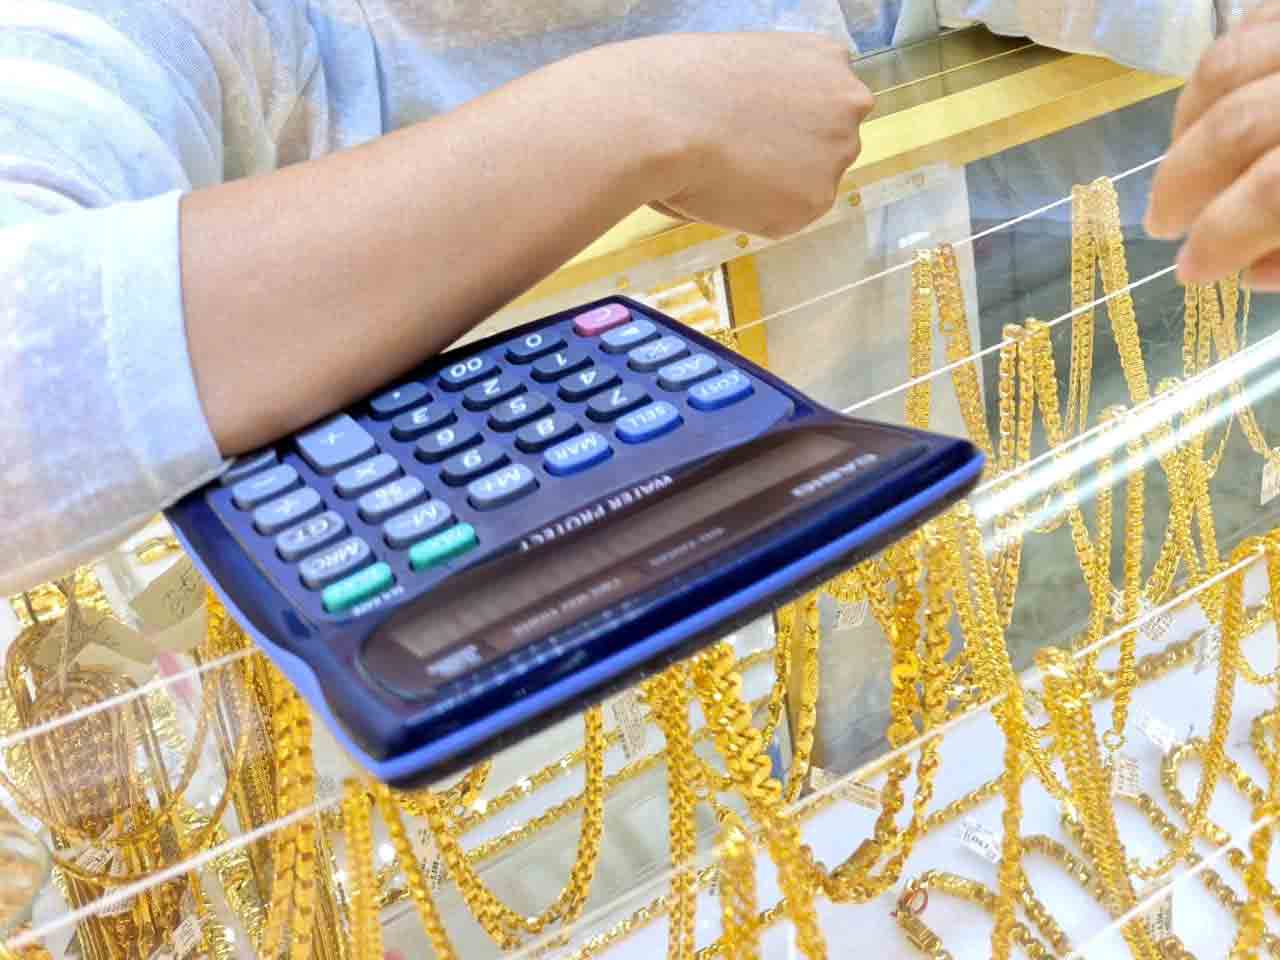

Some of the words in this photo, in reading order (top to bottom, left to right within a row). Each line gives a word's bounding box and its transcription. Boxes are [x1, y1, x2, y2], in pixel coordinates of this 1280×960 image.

[449, 356, 483, 378] 00
[555, 352, 568, 367] 1
[482, 377, 502, 396] 2
[579, 370, 597, 386] 4
[508, 396, 528, 414] 5
[609, 387, 628, 407] 7
[411, 407, 430, 425] 3
[535, 416, 555, 437] 8
[436, 428, 455, 447] 6
[462, 448, 482, 469] 9
[607, 474, 674, 511] WATER
